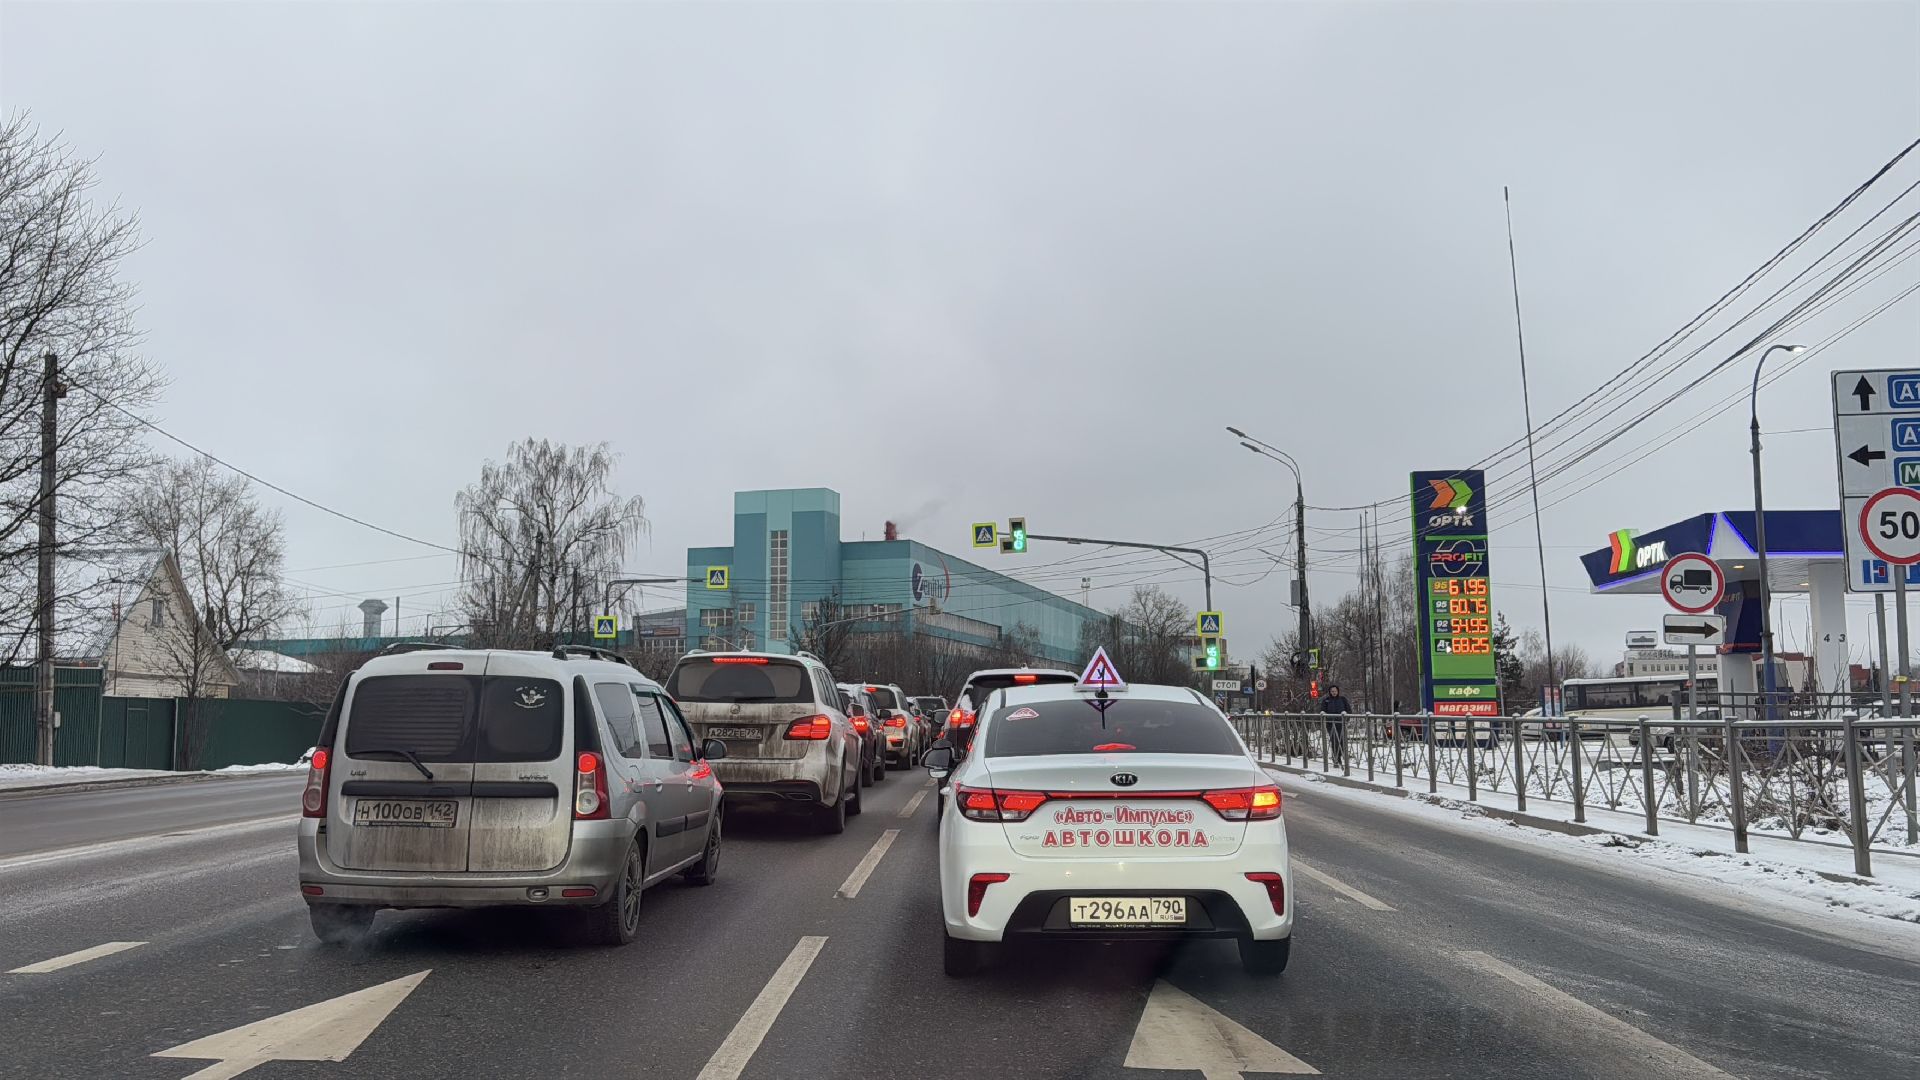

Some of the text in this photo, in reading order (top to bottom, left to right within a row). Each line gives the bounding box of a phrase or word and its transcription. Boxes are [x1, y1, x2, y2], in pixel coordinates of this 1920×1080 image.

[1880, 511, 1920, 539] 50
[1450, 598, 1487, 614] 60.75
[1451, 618, 1489, 634] 54.95
[1823, 633, 1831, 643] 4
[1838, 633, 1846, 643] 3
[1452, 638, 1490, 653] 68.25
[1215, 681, 1237, 689] СТОП
[1448, 686, 1481, 697] кафе
[1439, 704, 1492, 712] магазин
[1043, 830, 1208, 846] АВТОШКОЛА
